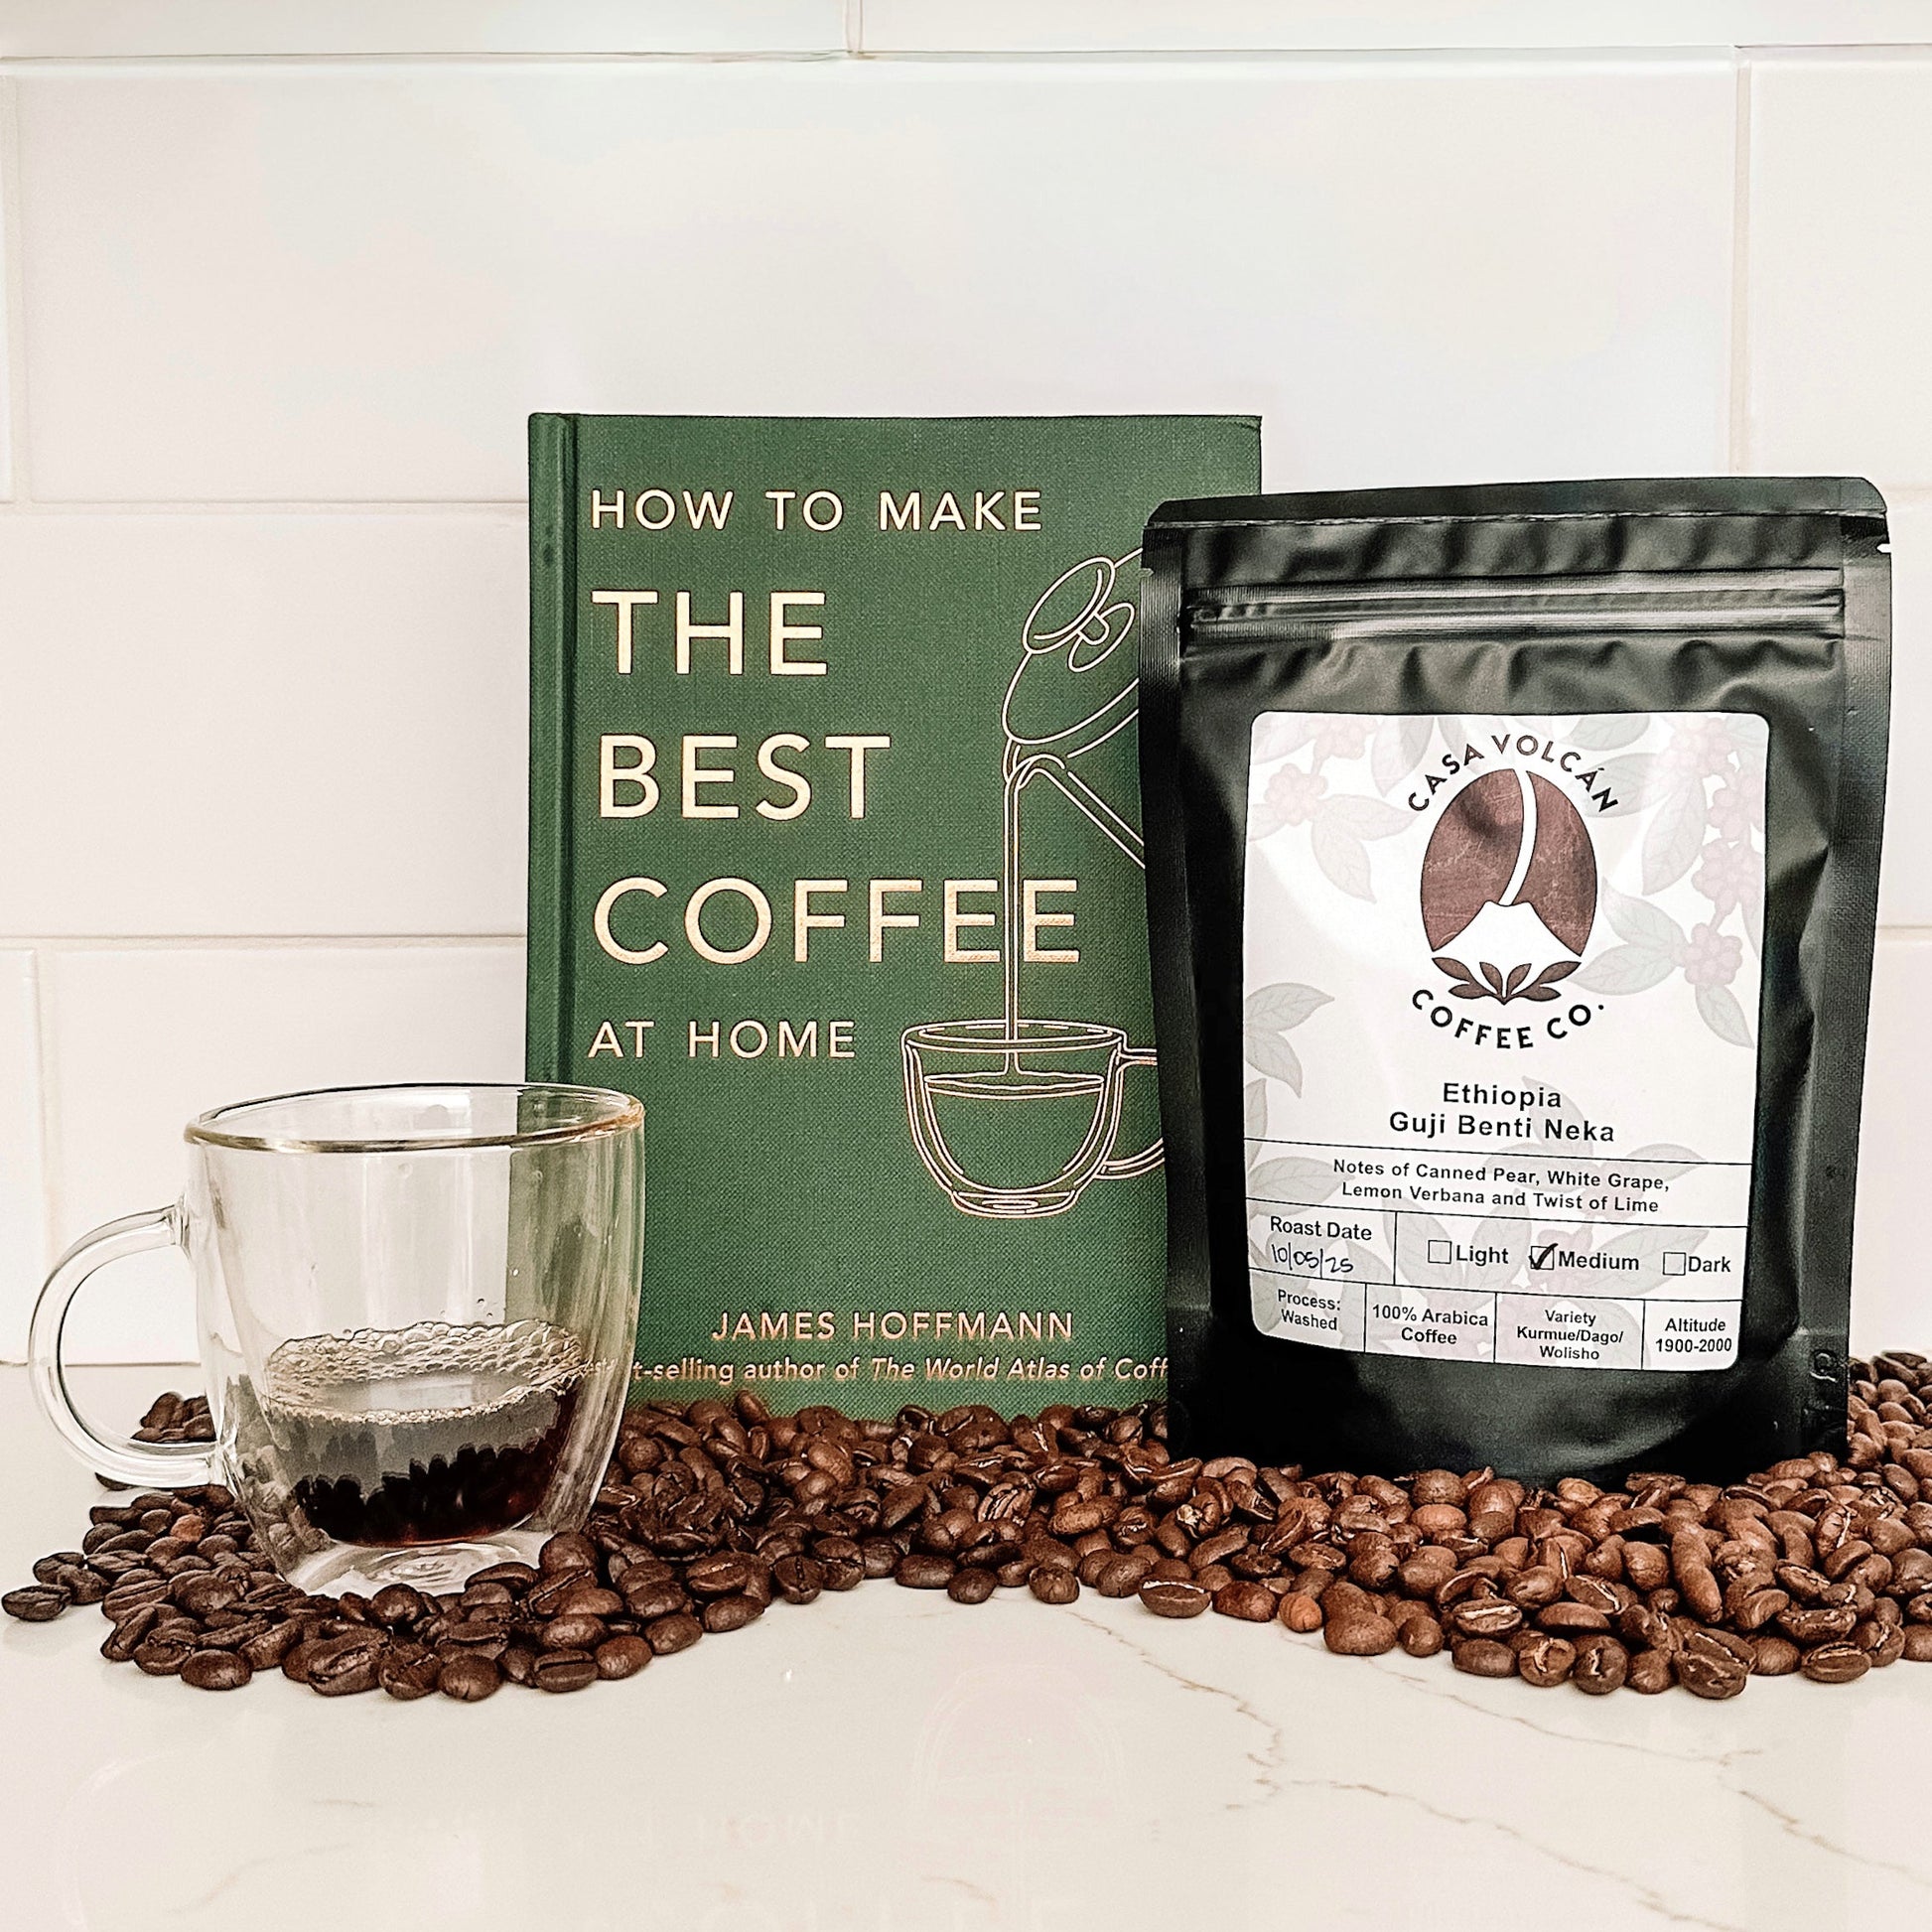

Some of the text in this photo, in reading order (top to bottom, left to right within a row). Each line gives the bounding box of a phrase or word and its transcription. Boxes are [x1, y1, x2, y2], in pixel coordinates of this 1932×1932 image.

[590, 488, 1043, 532] HOW TO MAKE
[591, 589, 829, 677] THE
[598, 733, 893, 821] BEST
[1407, 733, 1619, 814] CASA VOLCÁN
[593, 876, 1081, 966] COFFEE
[1411, 989, 1605, 1049] COFFEE CO.
[587, 1019, 857, 1059] AT HOME
[1443, 1082, 1563, 1110] Ethiopia
[1389, 1112, 1615, 1143] Guji Benti Neka
[1333, 1159, 1670, 1193] Notes of Canned Pear, White Grape,
[1341, 1182, 1659, 1212] Lemon Verbana and Twist of Lime
[1270, 1216, 1372, 1241] Roast Date
[1455, 1245, 1509, 1266] Light
[1558, 1251, 1640, 1271] Medium
[1688, 1256, 1731, 1273] Dark
[1278, 1289, 1341, 1311] Process:
[711, 1311, 1074, 1341] JAMES HOFFMANN
[1281, 1309, 1338, 1330] Washed
[1372, 1304, 1488, 1326] 100% Arabica
[1545, 1309, 1597, 1327] Variety
[1665, 1316, 1726, 1332] Altitude
[1401, 1327, 1457, 1345] Coffee
[1517, 1325, 1624, 1346] Kurmue/Dago/
[1655, 1338, 1732, 1353] 1900-2000
[1539, 1345, 1600, 1361] Wolisho
[631, 1356, 736, 1385] t-selling
[744, 1356, 826, 1381] author
[834, 1356, 861, 1381] of
[871, 1356, 915, 1380] The
[924, 1356, 1000, 1380] World
[1007, 1356, 1070, 1380] Atlas
[1079, 1356, 1108, 1381] of
[1114, 1356, 1170, 1381] Coff
